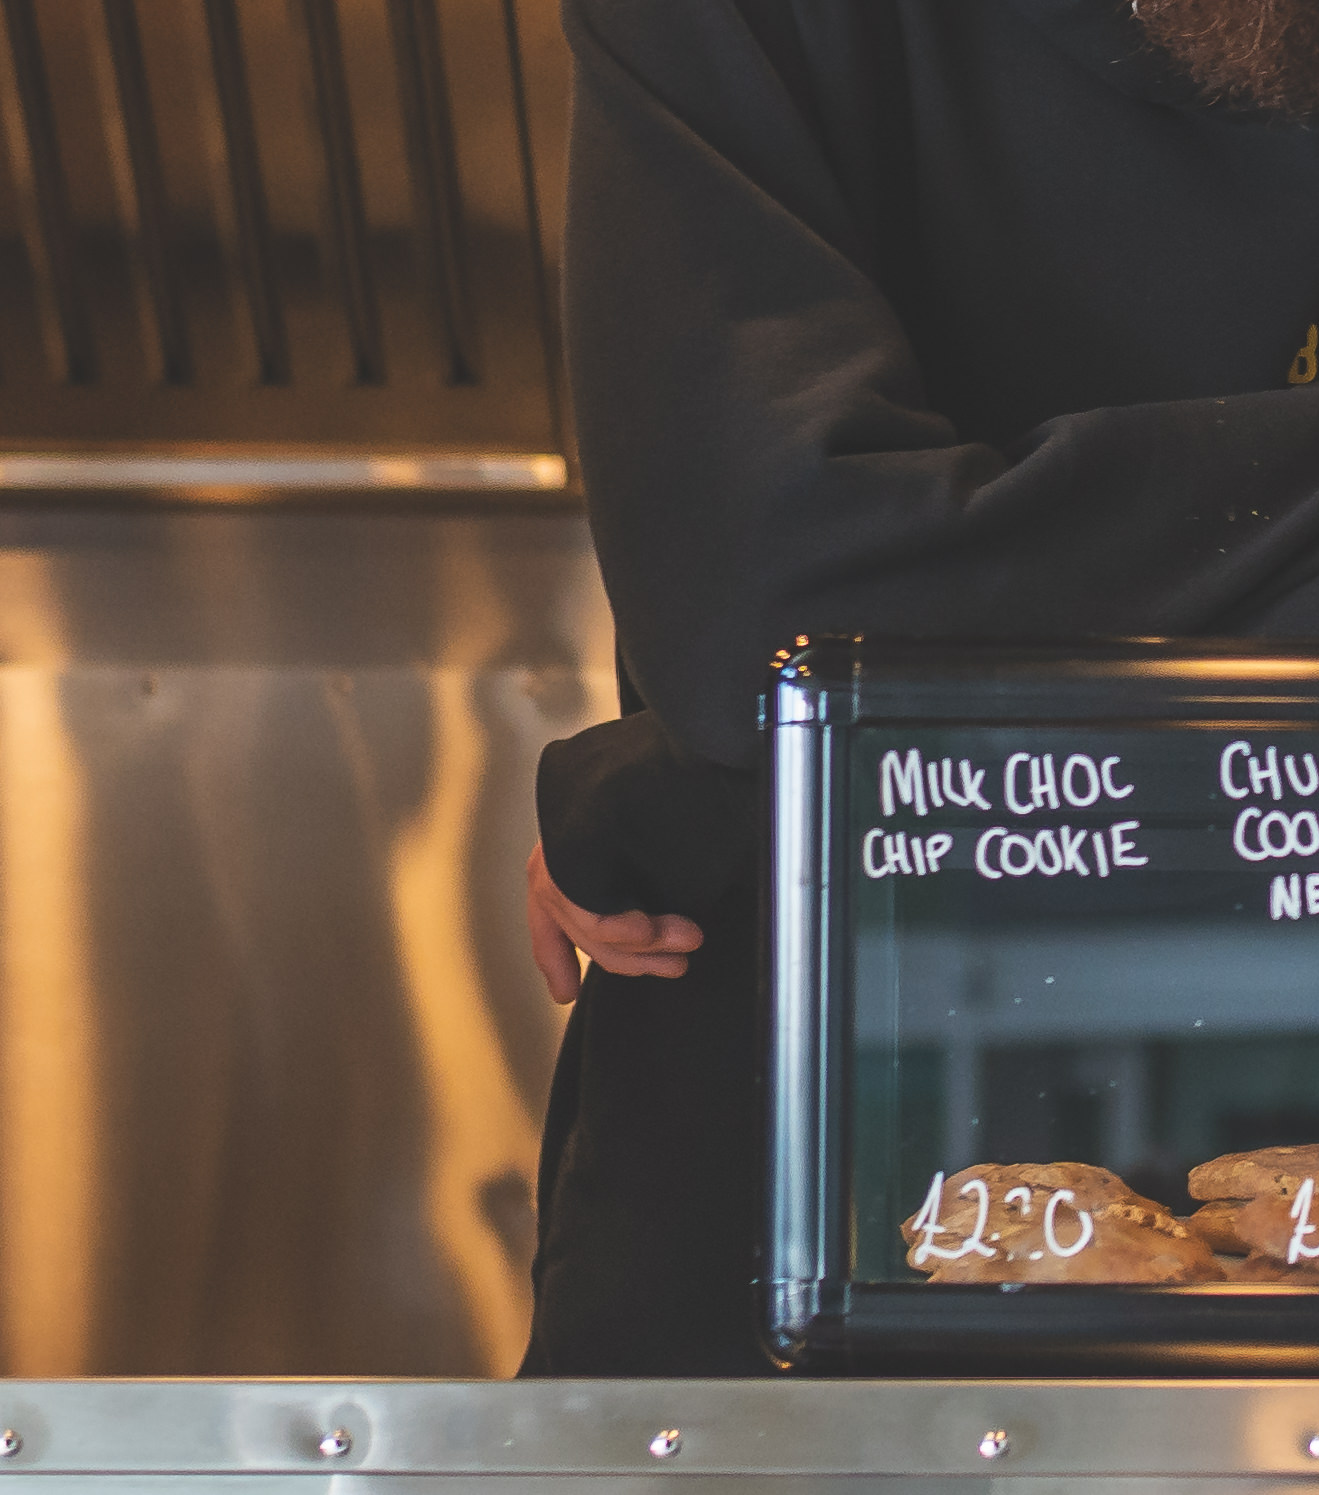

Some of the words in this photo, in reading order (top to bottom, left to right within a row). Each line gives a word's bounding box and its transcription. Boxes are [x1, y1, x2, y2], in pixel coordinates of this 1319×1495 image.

[1004, 751, 1134, 814] CHOC
[863, 827, 952, 879] CHIP
[975, 820, 1148, 879] COOKIE
